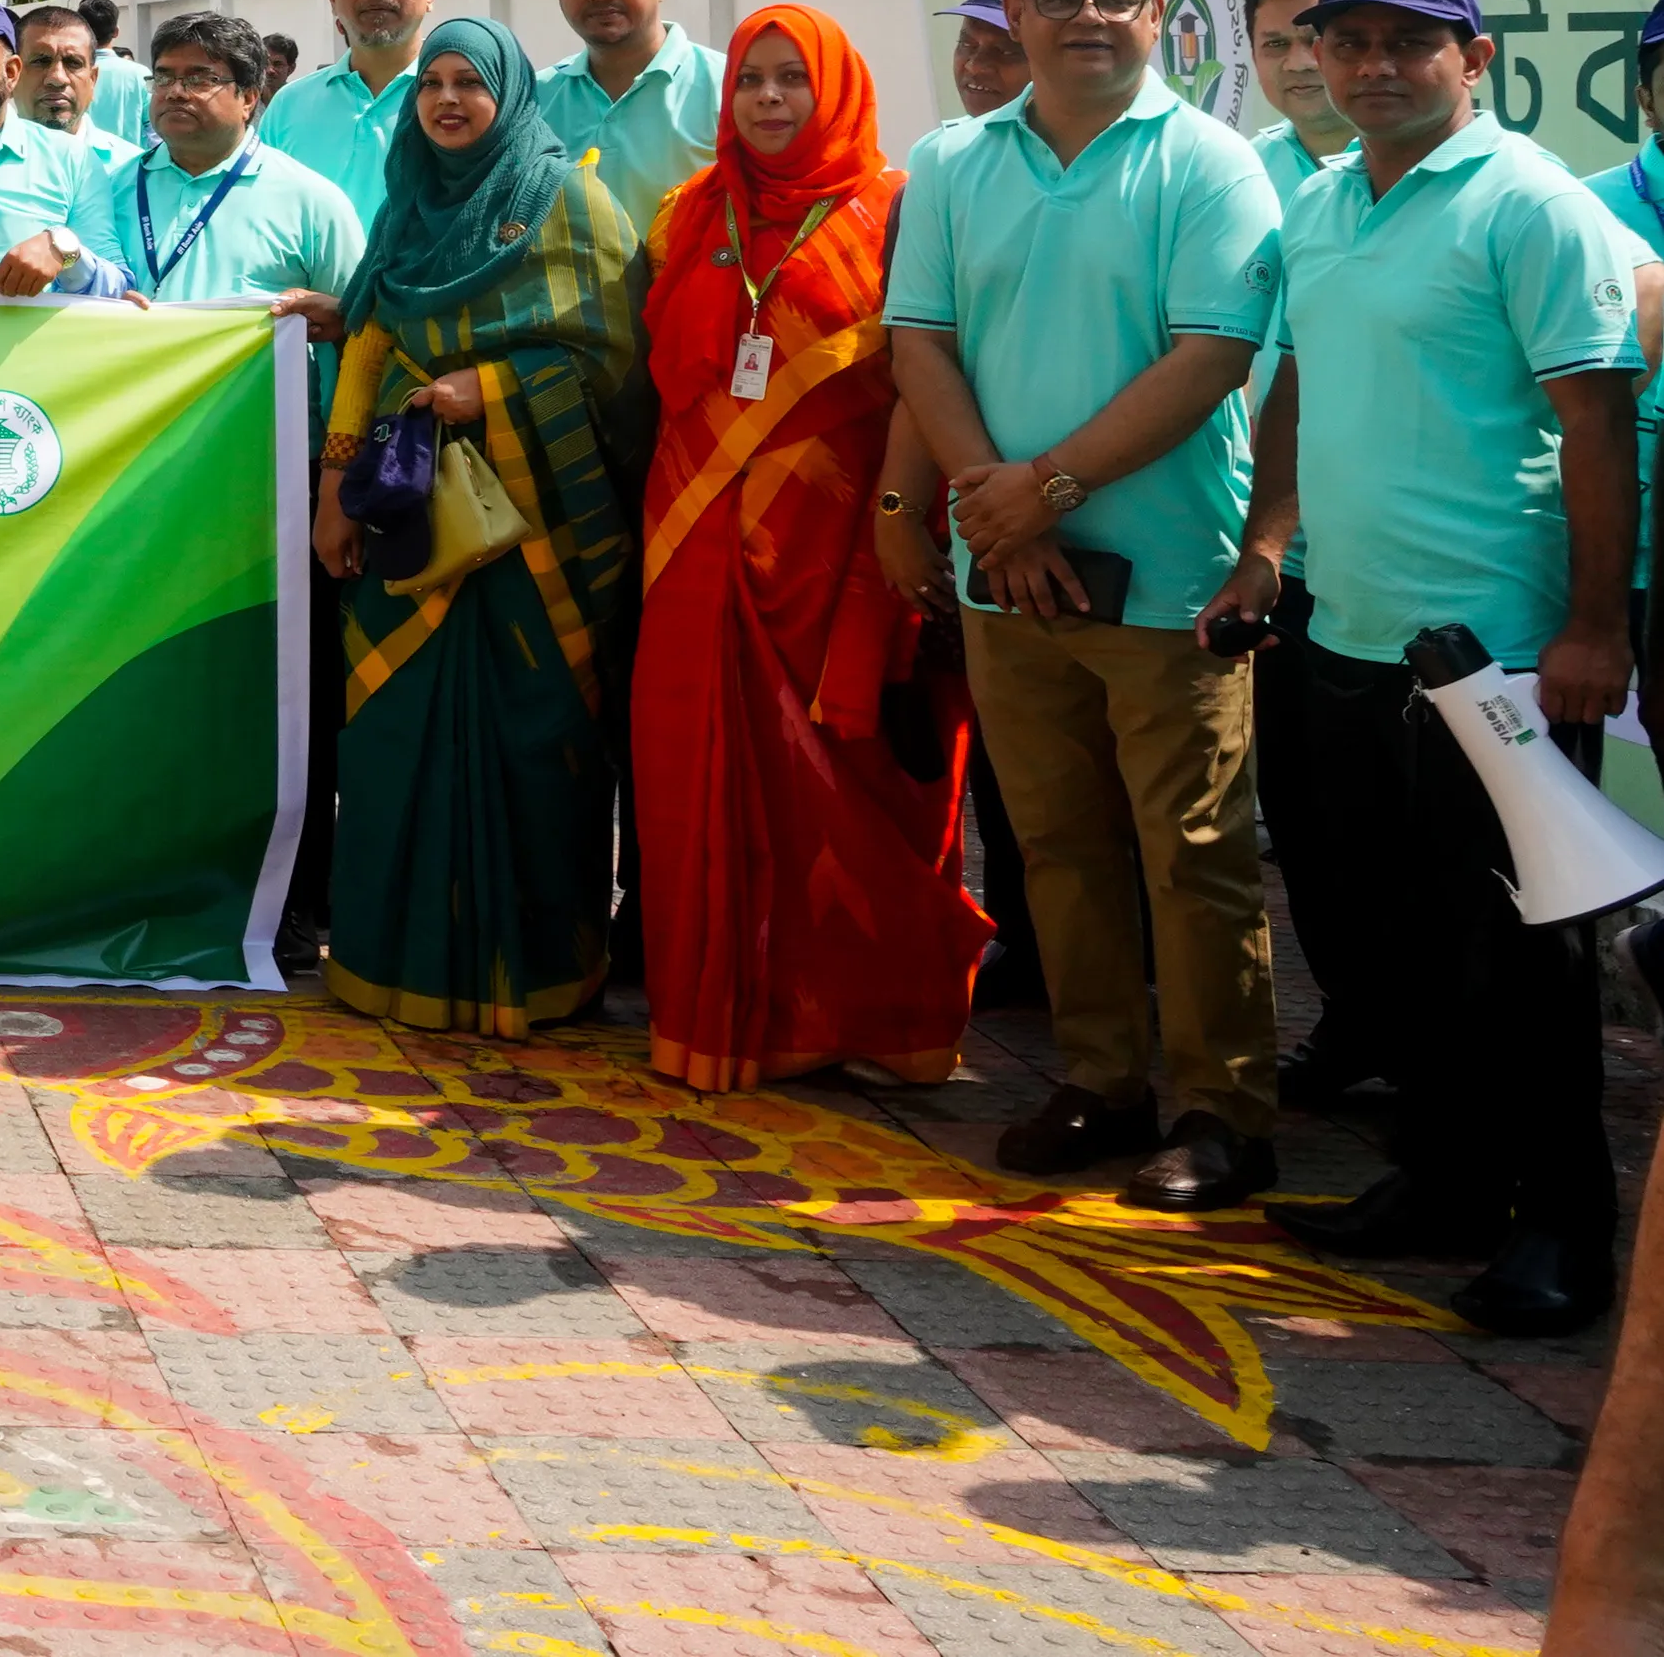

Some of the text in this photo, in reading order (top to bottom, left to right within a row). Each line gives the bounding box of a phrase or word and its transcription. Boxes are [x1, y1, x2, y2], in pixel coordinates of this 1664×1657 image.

[182, 221, 205, 249] Bank Asia
[14, 402, 44, 435] ব্যাংক
